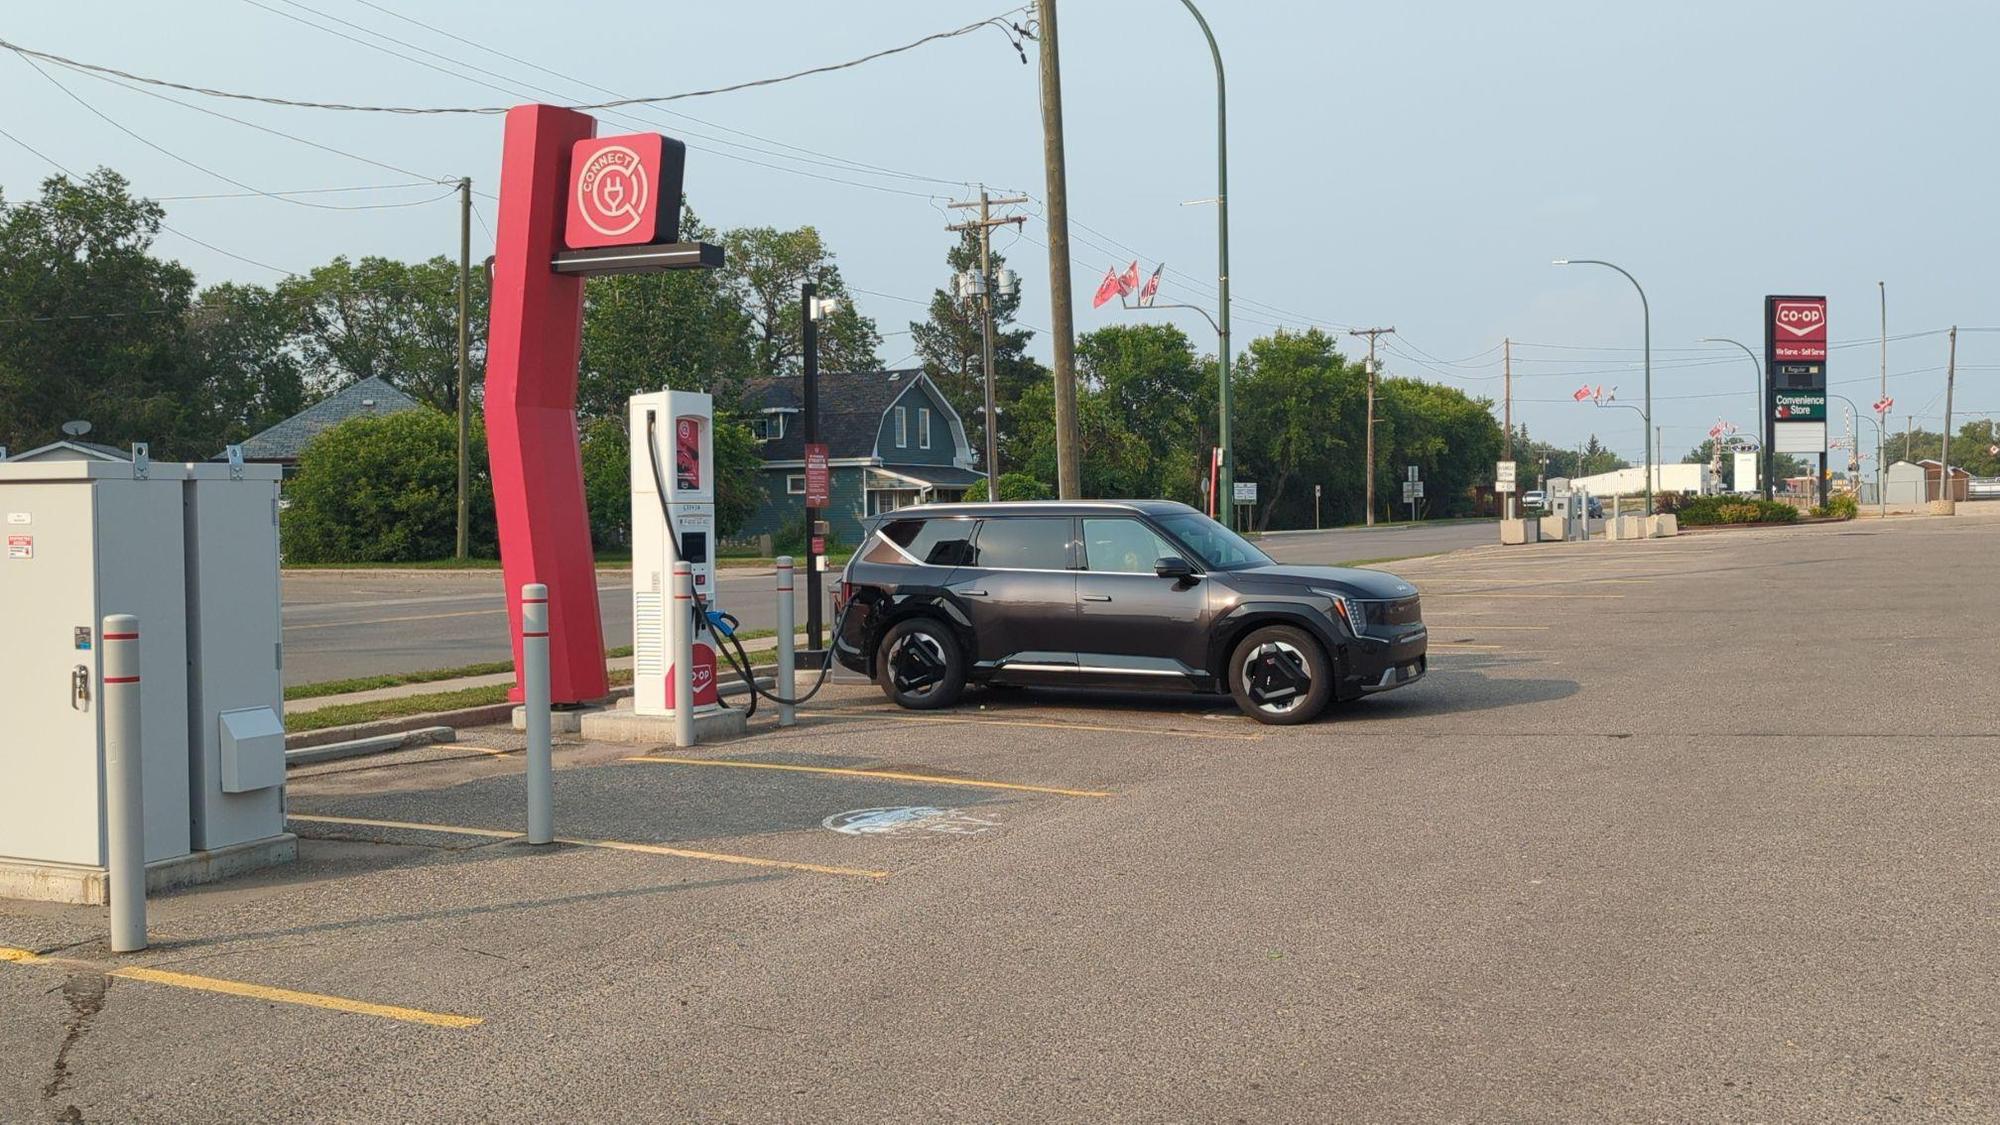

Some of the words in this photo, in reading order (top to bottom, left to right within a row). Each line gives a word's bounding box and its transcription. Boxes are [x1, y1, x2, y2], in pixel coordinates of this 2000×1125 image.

[584, 153, 632, 192] CONNECT
[1776, 395, 1824, 405] Convenience
[1790, 405, 1811, 415] Store
